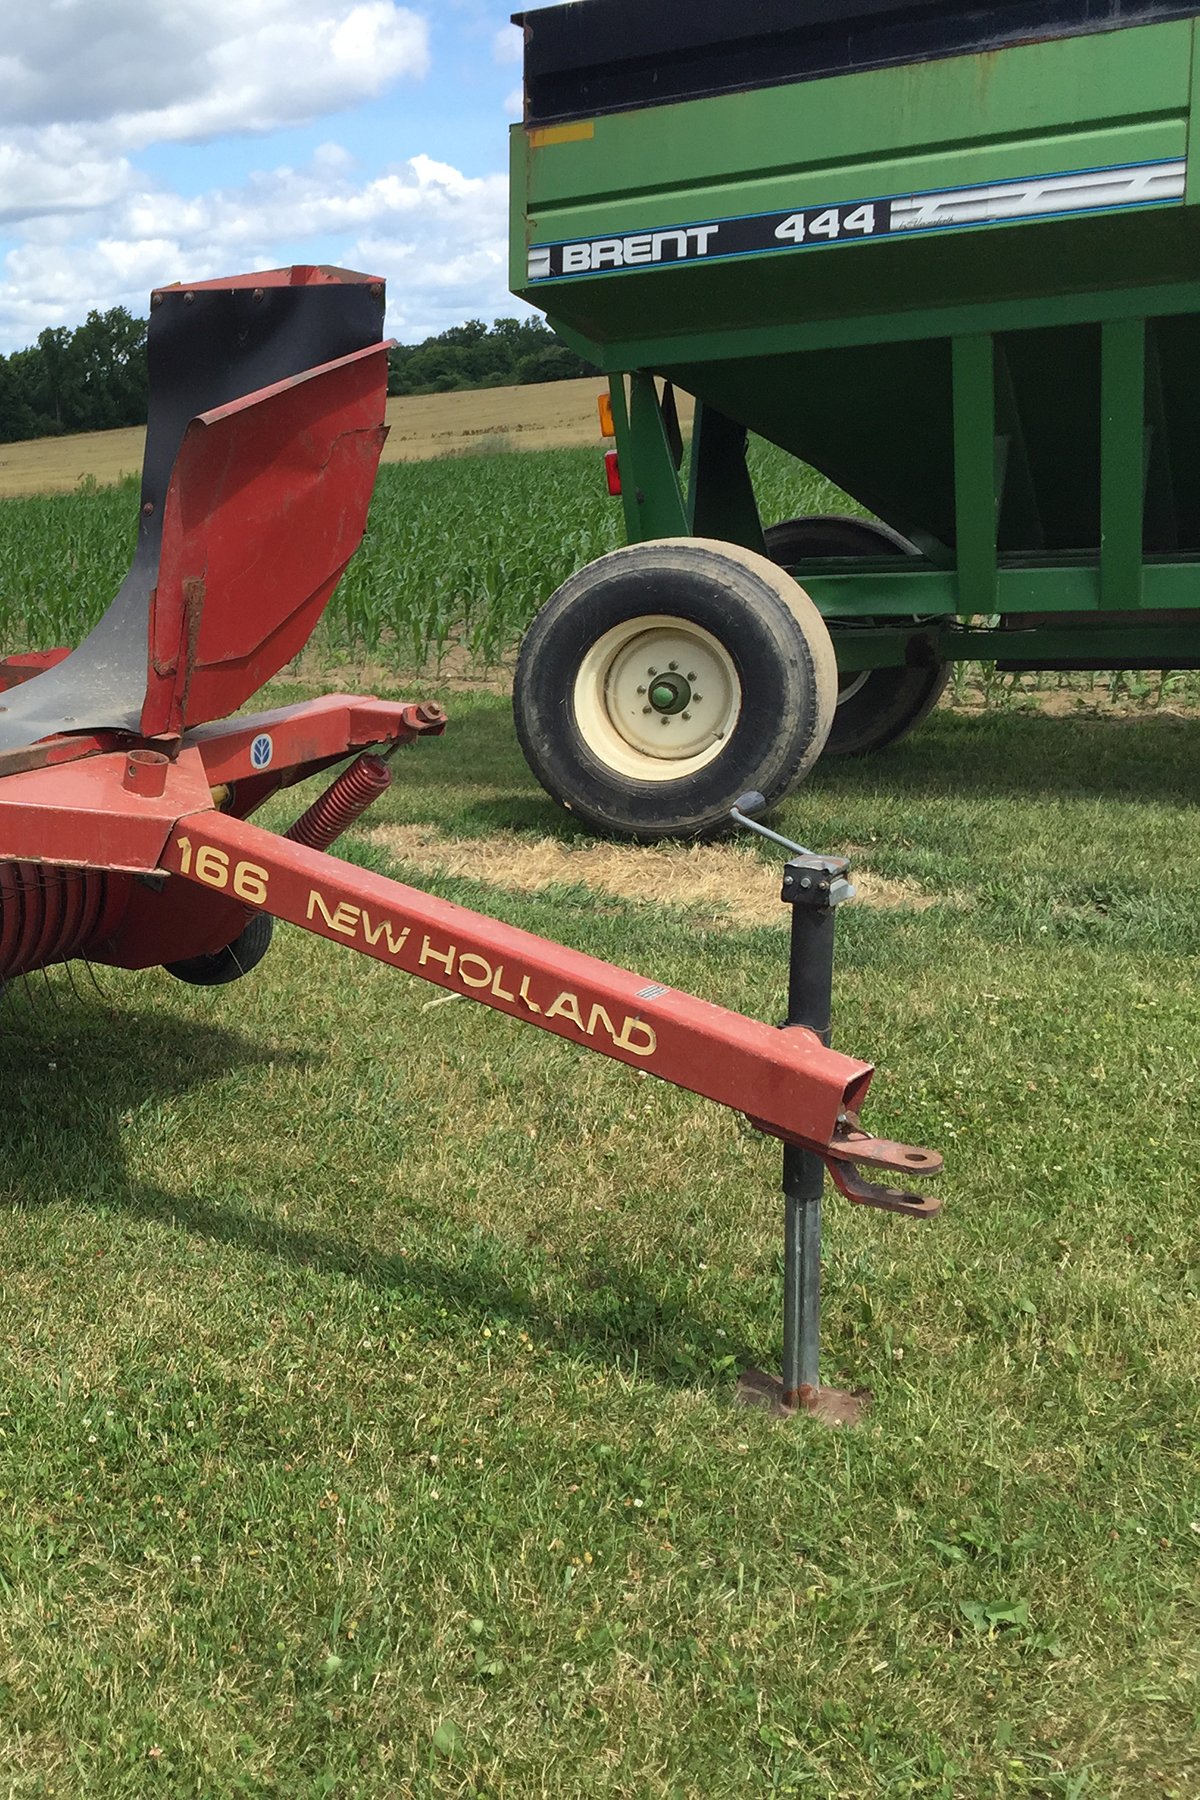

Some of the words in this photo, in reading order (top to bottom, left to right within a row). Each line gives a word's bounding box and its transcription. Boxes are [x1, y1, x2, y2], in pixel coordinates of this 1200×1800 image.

[562, 225, 719, 273] BRENT
[774, 204, 876, 242] 444
[177, 837, 269, 905] 166
[306, 889, 411, 954] NEW
[418, 935, 657, 1056] HOLLAND
